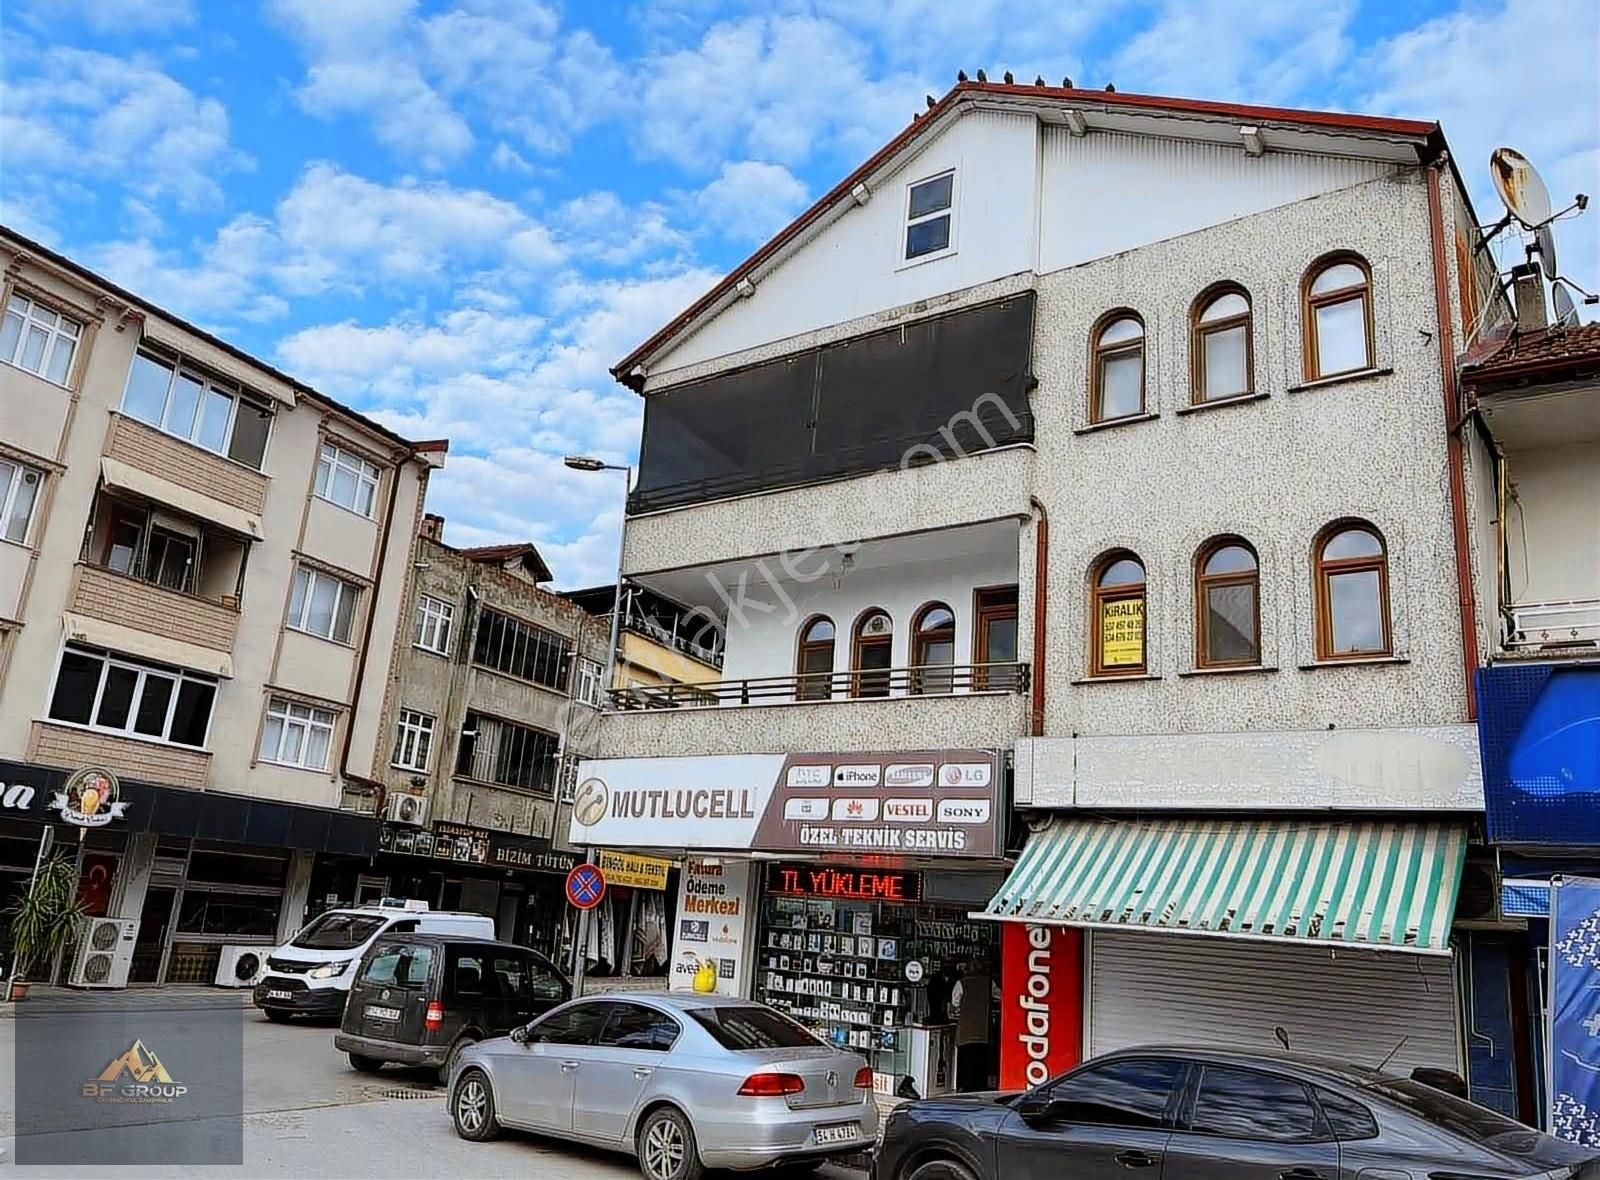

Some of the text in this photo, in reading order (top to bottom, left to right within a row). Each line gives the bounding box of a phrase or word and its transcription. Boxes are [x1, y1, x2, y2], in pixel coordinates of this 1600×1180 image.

[845, 773, 878, 782] iPhone
[965, 770, 984, 780] LG
[611, 788, 756, 819] MUTLUCELL
[887, 804, 930, 817] VESTEL
[944, 806, 983, 818] SONY
[799, 823, 967, 850] ÖZEL TEKNİK SERVİS
[686, 875, 726, 895] Ödeme
[780, 868, 904, 898] TL YÜKLEME
[1018, 925, 1050, 1090] odafone
